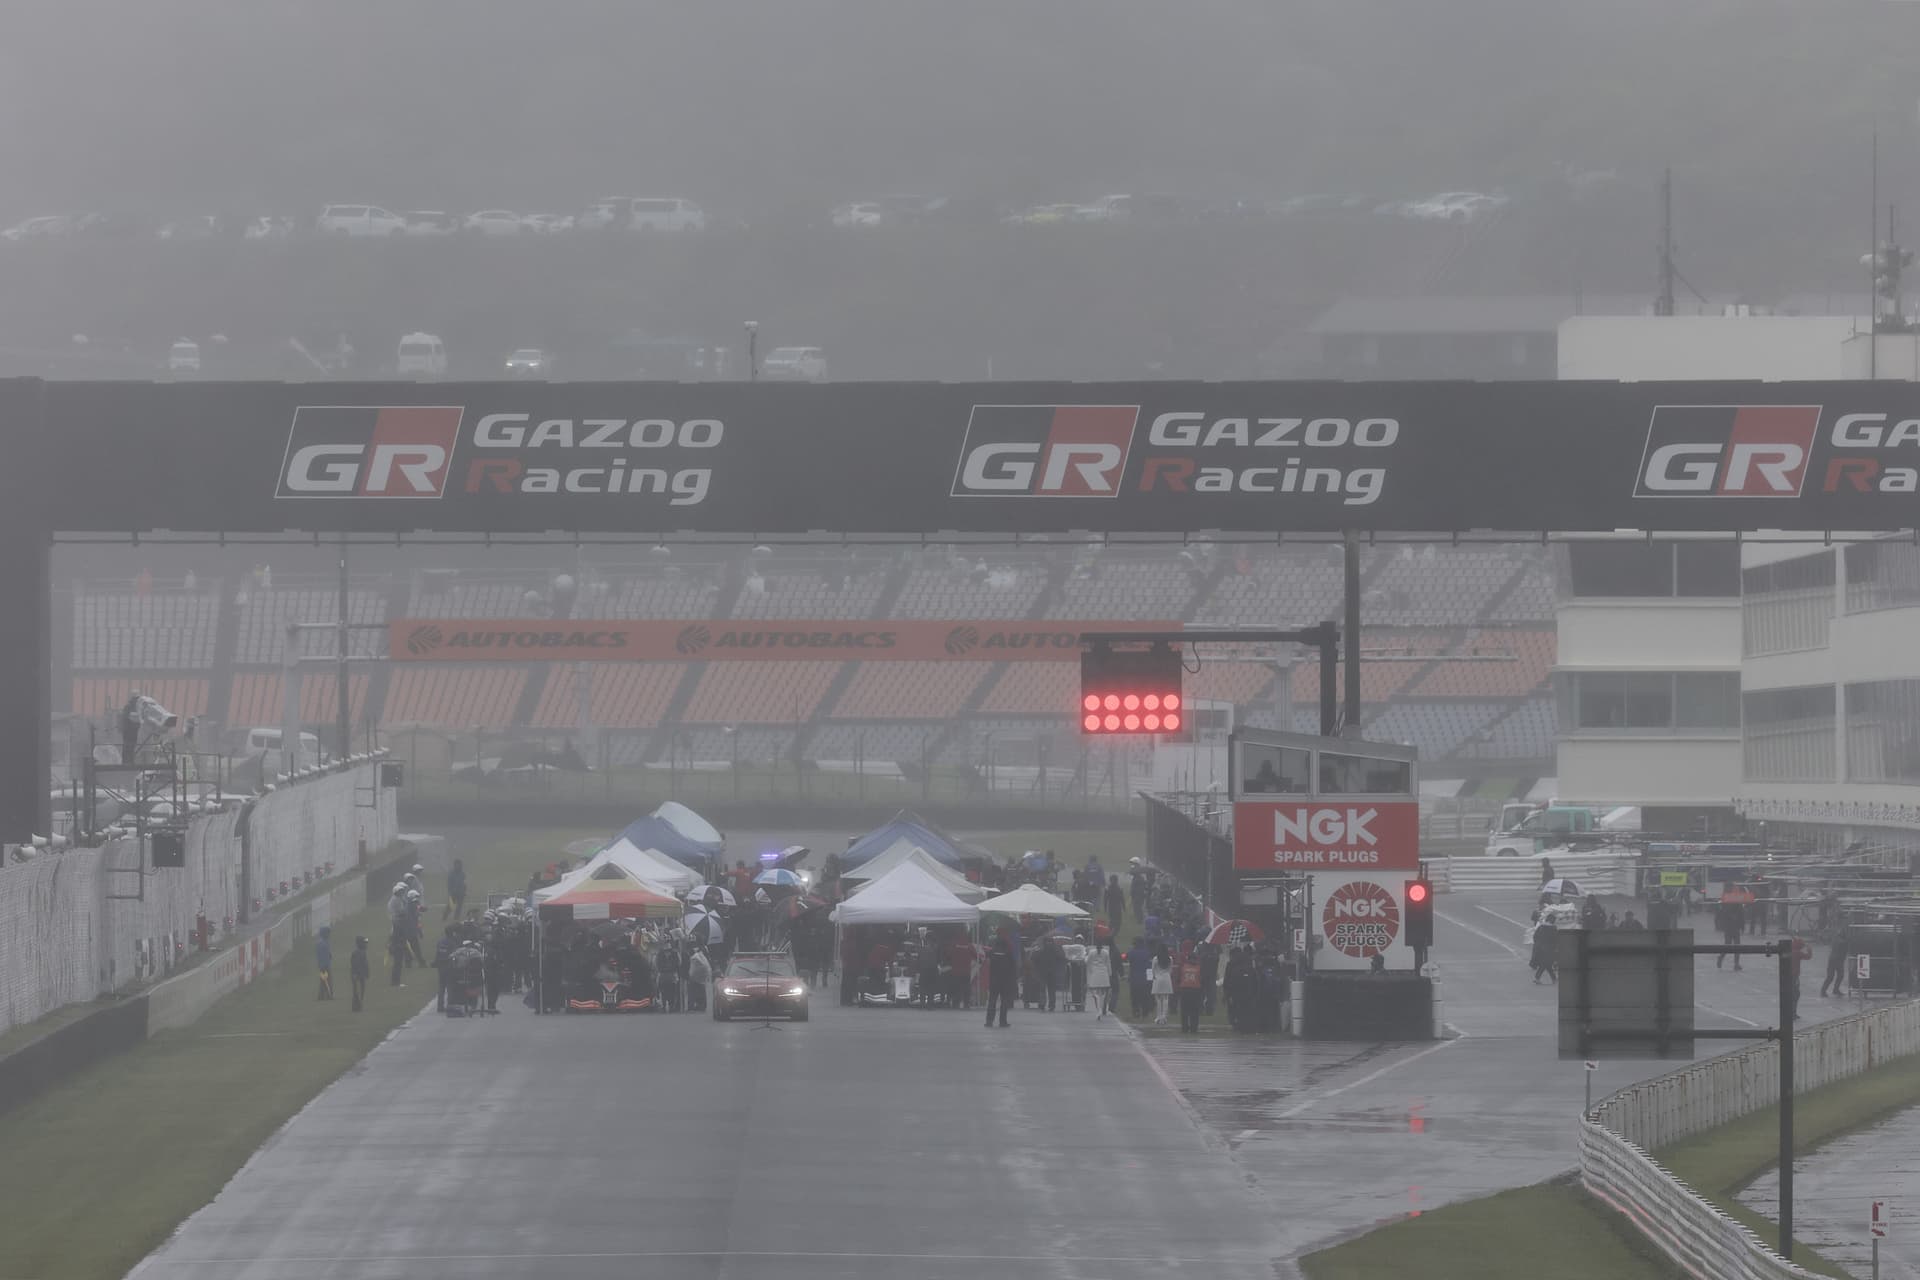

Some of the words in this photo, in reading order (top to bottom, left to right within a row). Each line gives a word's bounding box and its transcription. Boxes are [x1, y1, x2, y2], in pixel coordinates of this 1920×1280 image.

[473, 413, 724, 448] GAZOO
[1149, 412, 1399, 447] GAZOO
[286, 443, 447, 492] GR
[465, 458, 712, 505] Racing
[962, 442, 1123, 491] GR
[1140, 457, 1387, 505] Racing
[1644, 442, 1804, 491] GR
[447, 631, 629, 649] AUTOBACS
[713, 631, 897, 649] AUTOBACS
[1274, 808, 1378, 846] NGK
[1274, 851, 1325, 863] SPARK
[1328, 851, 1379, 863] PLUGS
[1334, 898, 1387, 917] NGK
[1336, 922, 1385, 935] SPARK
[1336, 936, 1387, 947] PLUGS
